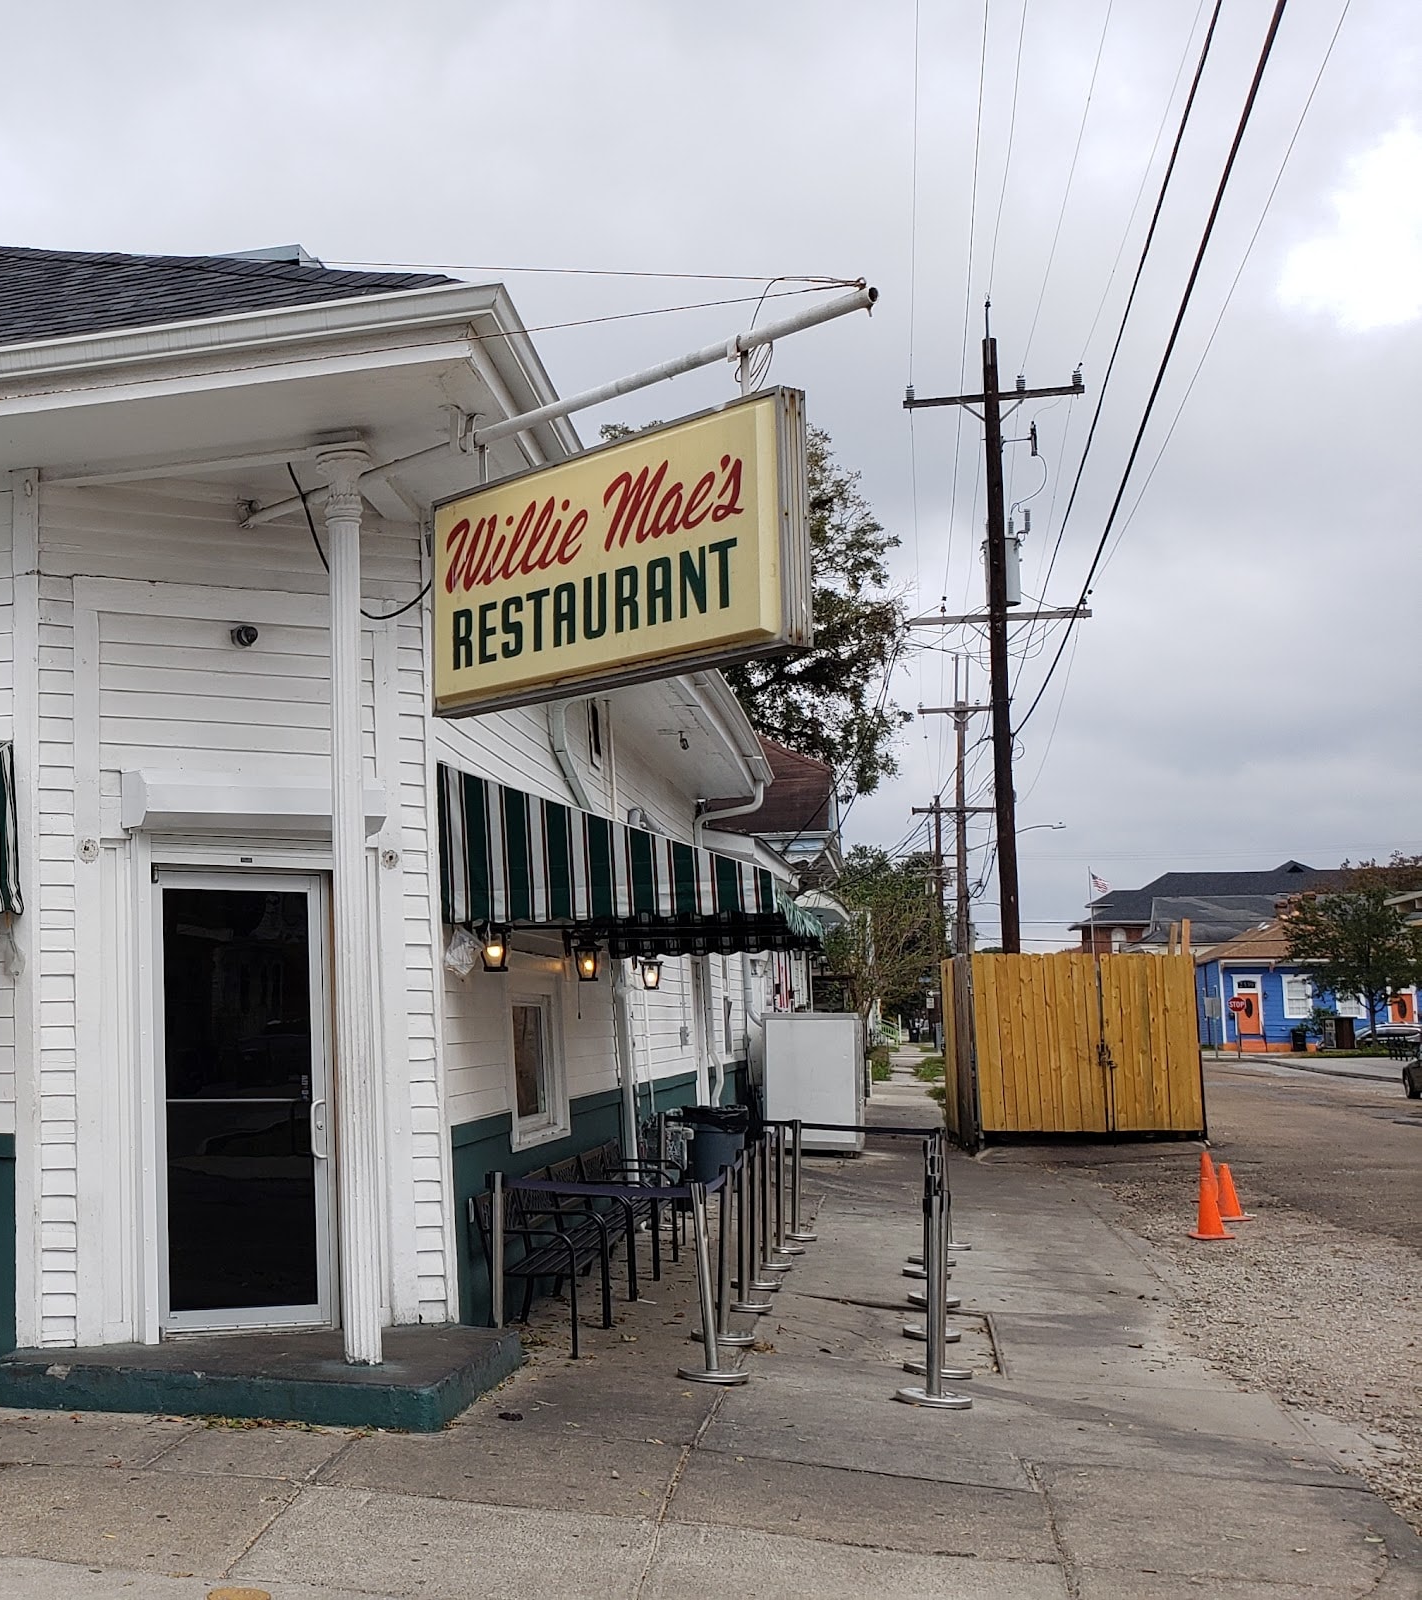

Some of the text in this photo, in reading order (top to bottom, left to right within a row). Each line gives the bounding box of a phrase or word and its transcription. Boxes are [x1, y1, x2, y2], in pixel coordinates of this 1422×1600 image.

[445, 454, 745, 594] Willie Mae's
[451, 536, 738, 671] RESTAURANT
